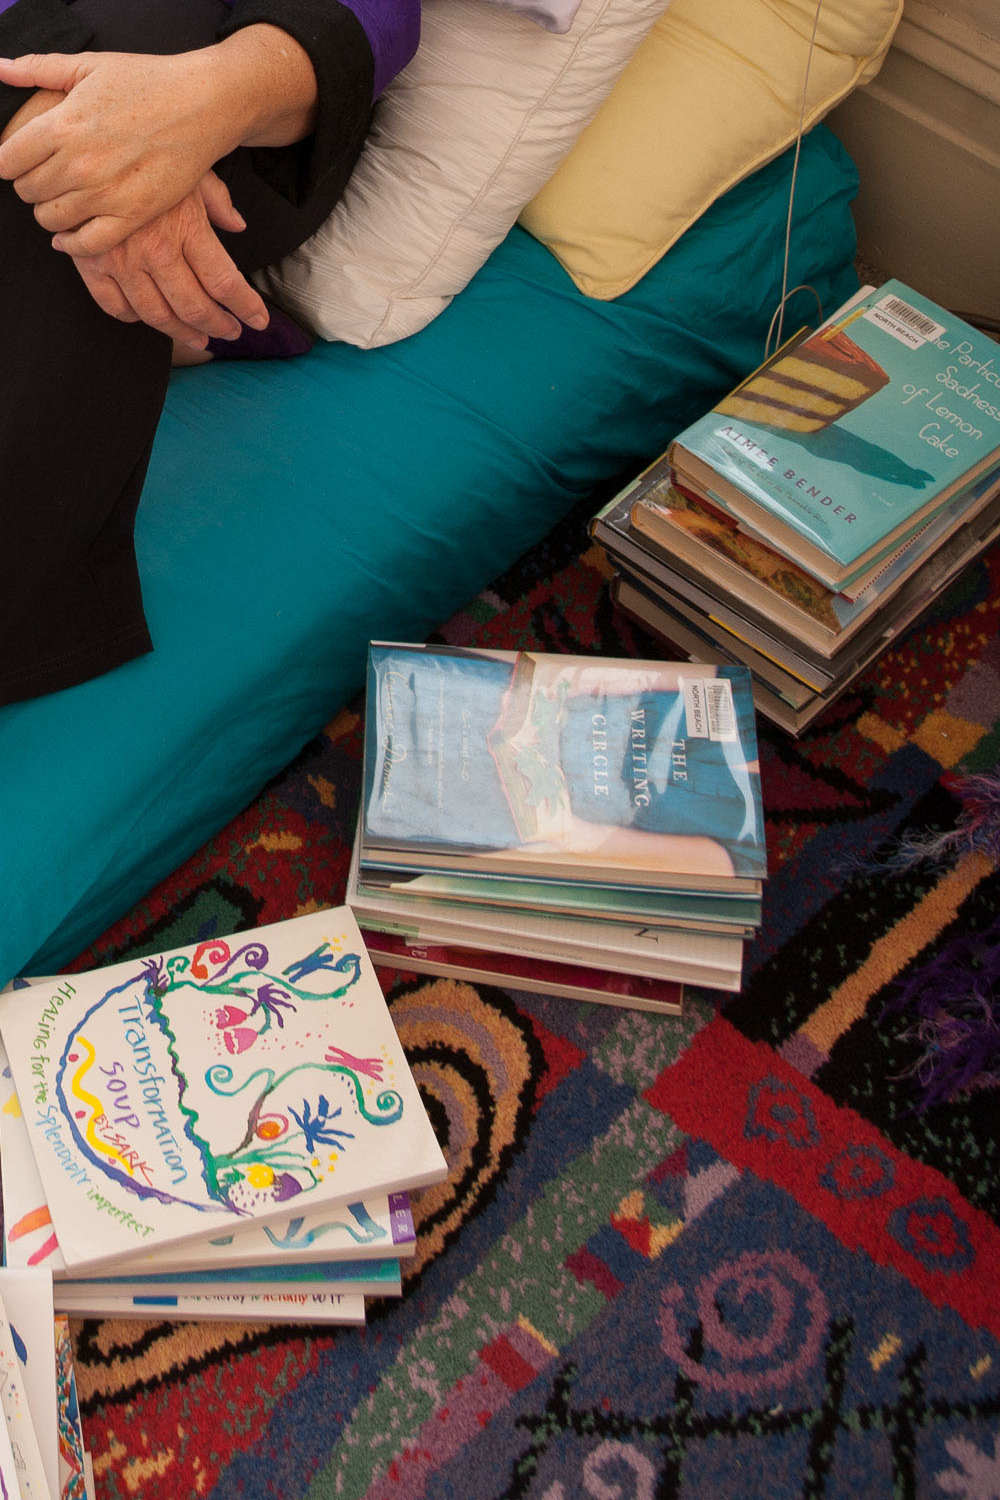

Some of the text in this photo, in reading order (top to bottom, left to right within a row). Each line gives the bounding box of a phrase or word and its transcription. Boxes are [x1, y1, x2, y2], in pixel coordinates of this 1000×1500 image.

[873, 312, 896, 329] NORTH
[896, 326, 919, 344] BEACH
[902, 383, 983, 440] of Lemon
[918, 422, 959, 459] Cake
[720, 425, 858, 524] AIMEE BENDER
[692, 684, 702, 733] NORTH BEACH
[592, 714, 609, 796] CIRCLE
[630, 708, 650, 807] WRITING
[672, 739, 687, 781] THE
[94, 1114, 155, 1187] BY SARK
